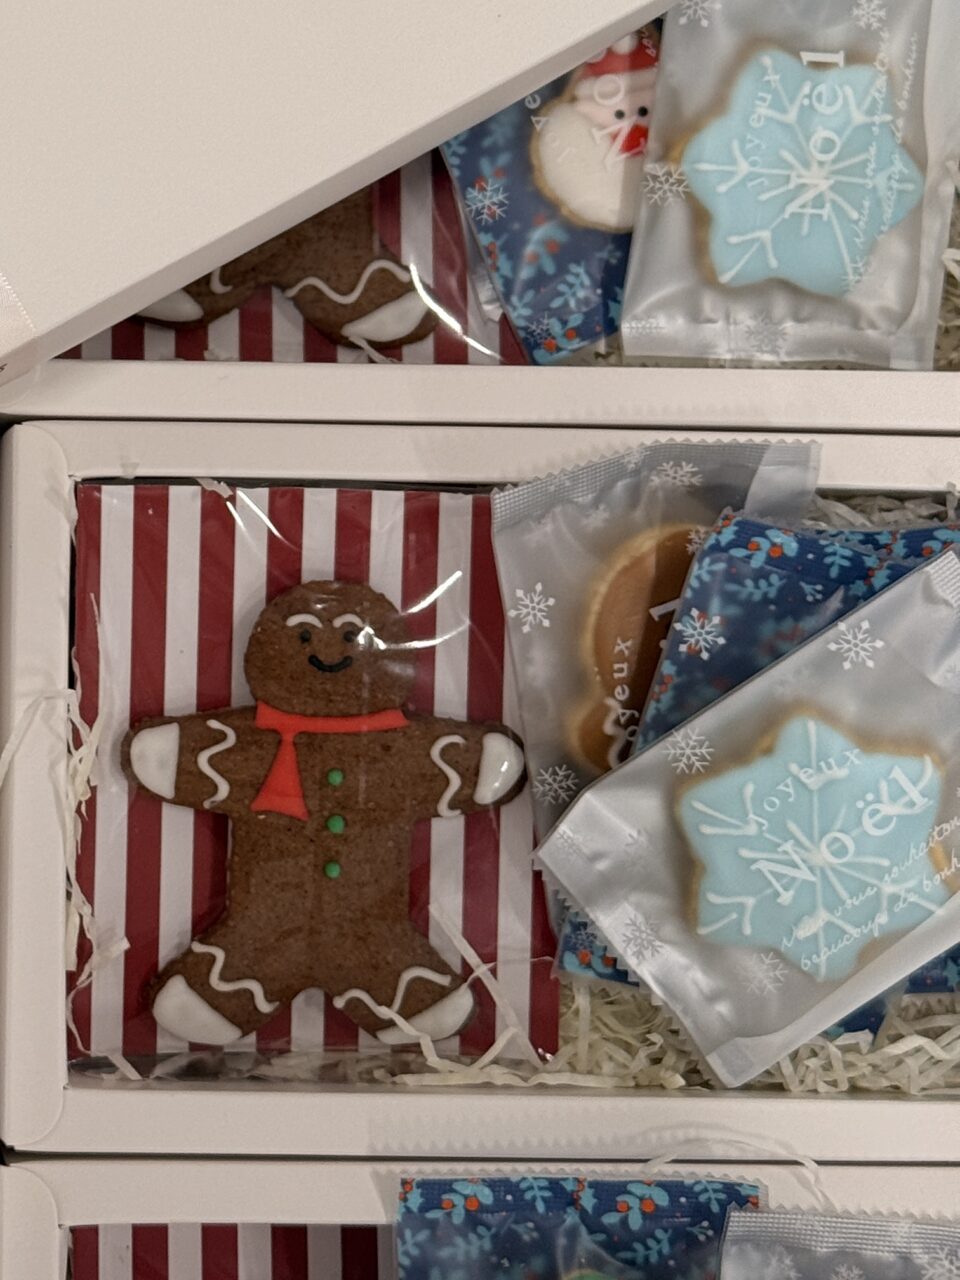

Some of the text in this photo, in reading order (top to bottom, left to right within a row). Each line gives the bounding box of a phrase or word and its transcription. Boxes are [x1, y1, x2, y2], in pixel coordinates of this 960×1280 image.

[784, 50, 845, 221] Noël
[749, 748, 862, 830] Joyeux
[750, 765, 929, 907] Noël
